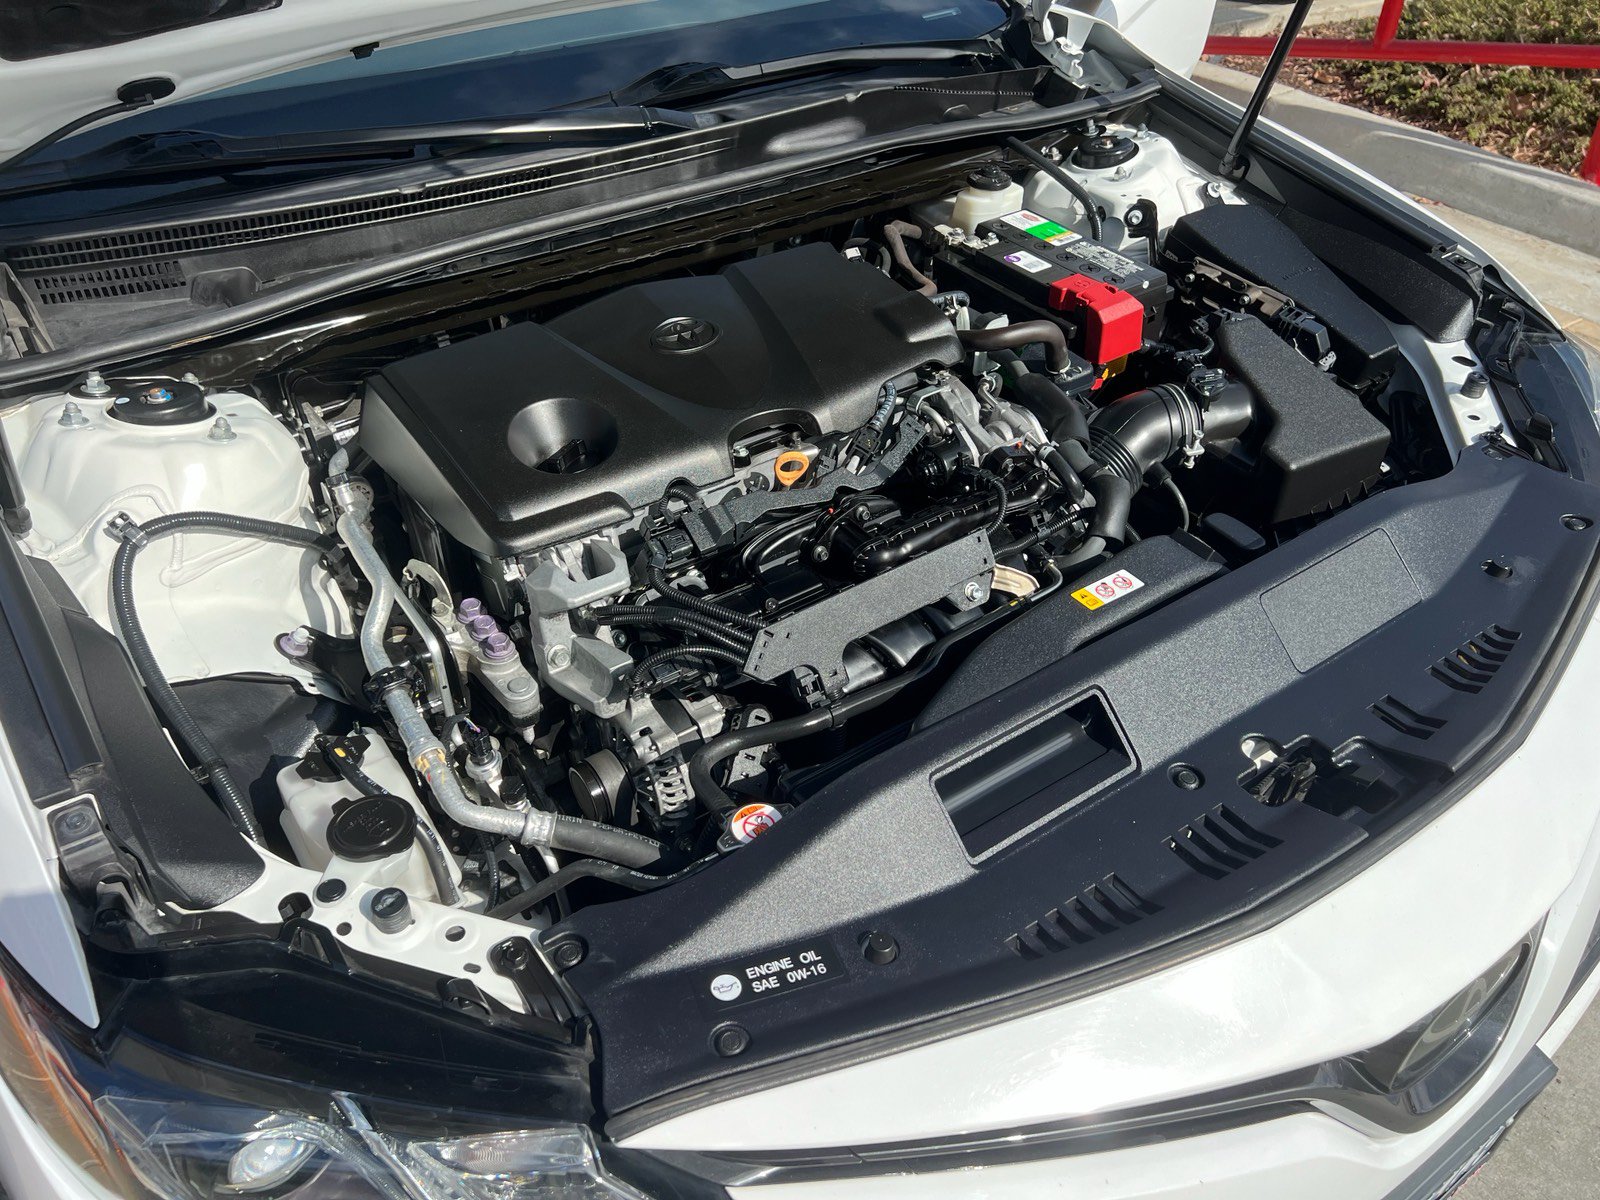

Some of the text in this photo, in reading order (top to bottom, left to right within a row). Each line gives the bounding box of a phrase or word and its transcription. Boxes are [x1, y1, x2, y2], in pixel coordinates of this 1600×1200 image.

[745, 950, 822, 979] ENGINE OIL
[752, 963, 827, 993] SAE 0W-16
